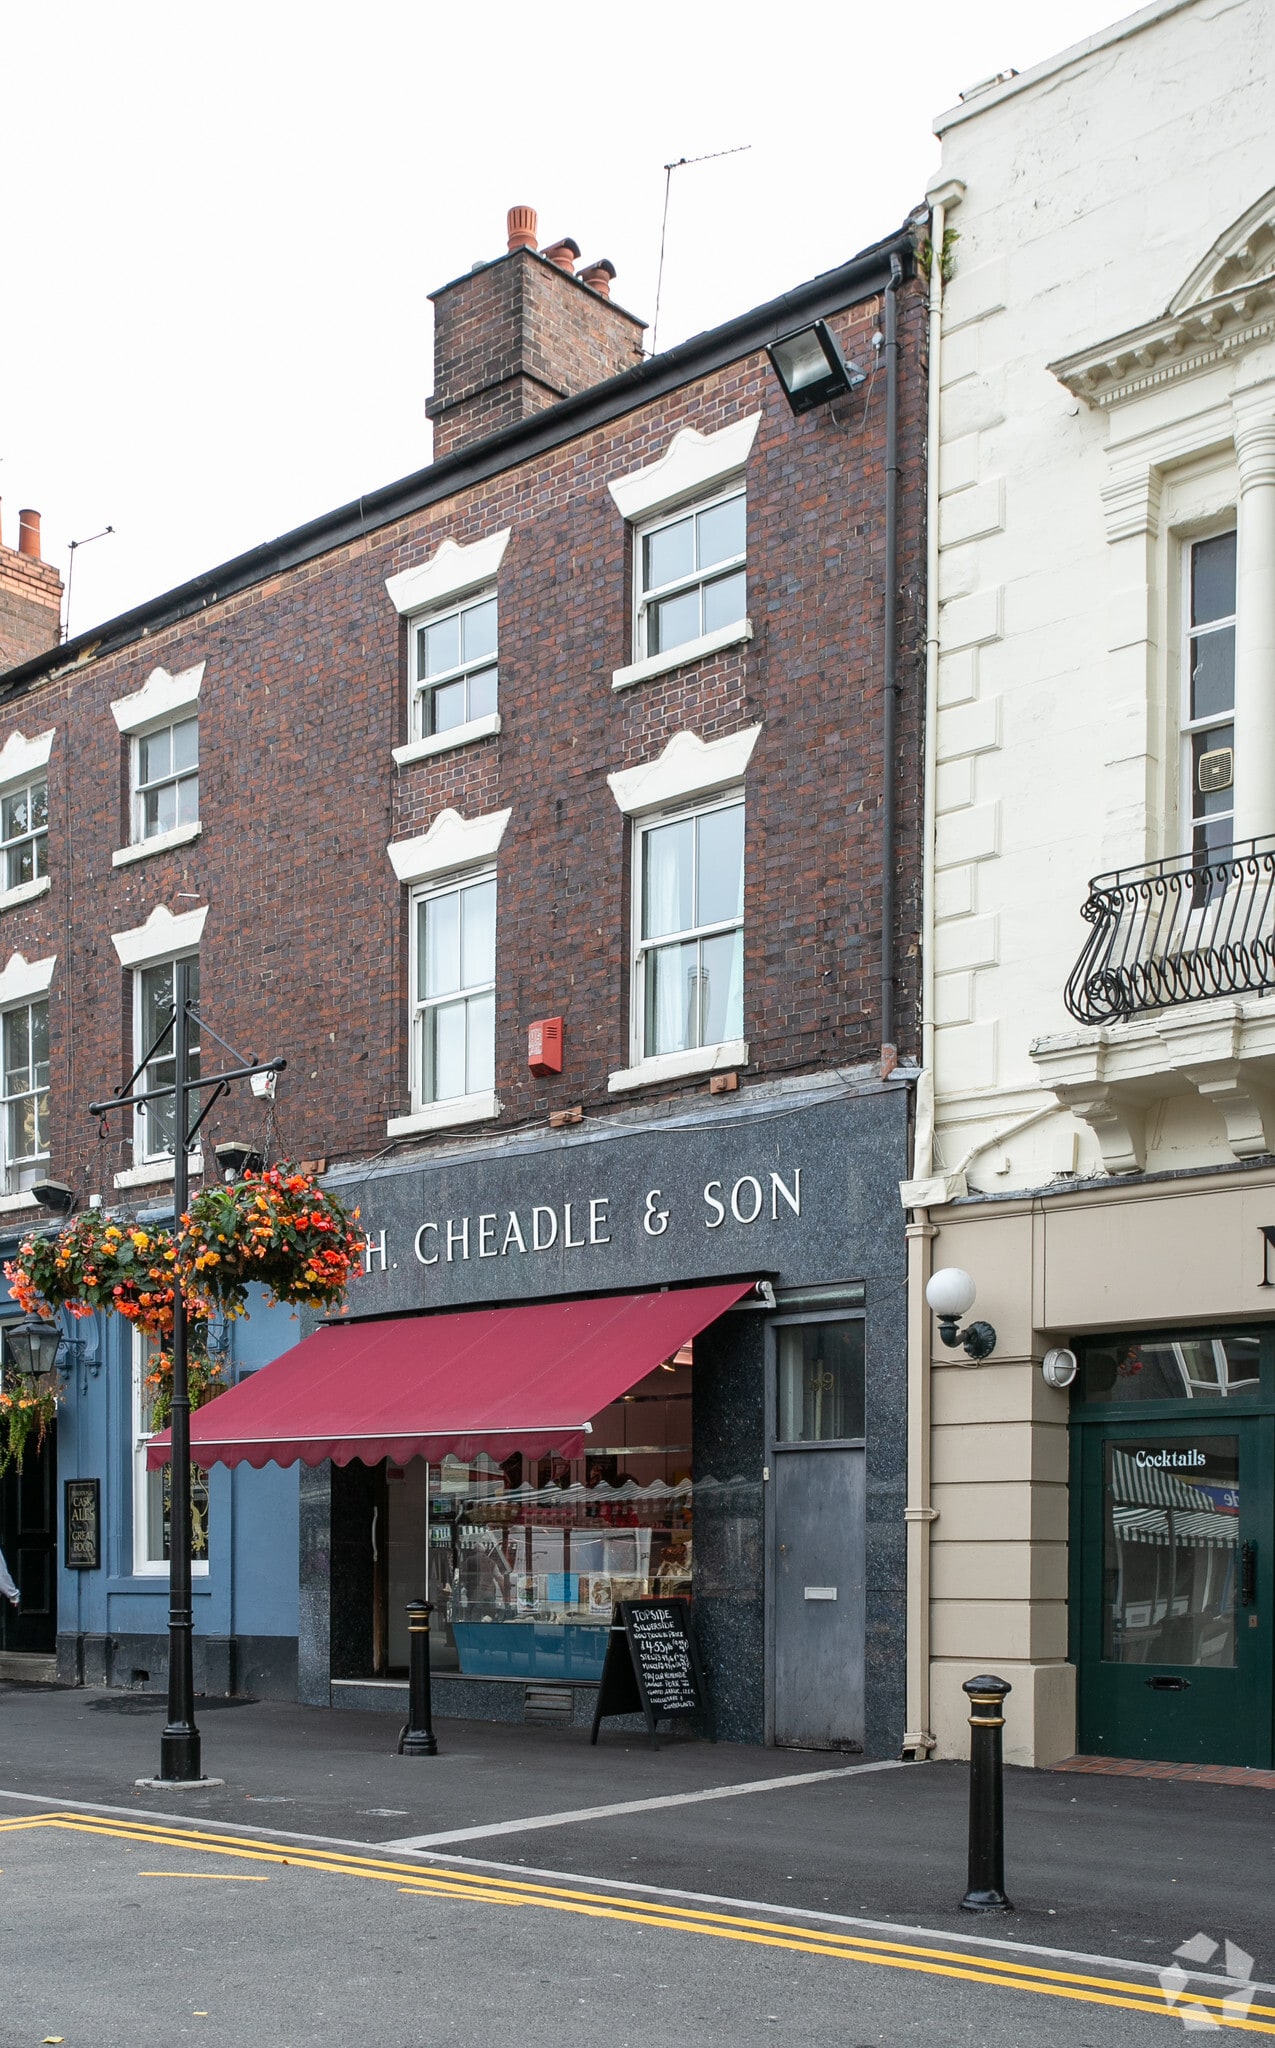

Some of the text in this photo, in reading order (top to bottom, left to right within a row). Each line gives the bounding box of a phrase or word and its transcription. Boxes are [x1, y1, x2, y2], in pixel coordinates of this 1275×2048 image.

[365, 1168, 802, 1273] H. CHEADLE & SON
[1136, 1449, 1206, 1468] Cocktails
[73, 1497, 92, 1507] CASK
[71, 1508, 95, 1521] ALES
[73, 1542, 93, 1552] FOOD
[631, 1609, 672, 1622] TOPSIDE
[633, 1621, 675, 1632] SILVERSIDE
